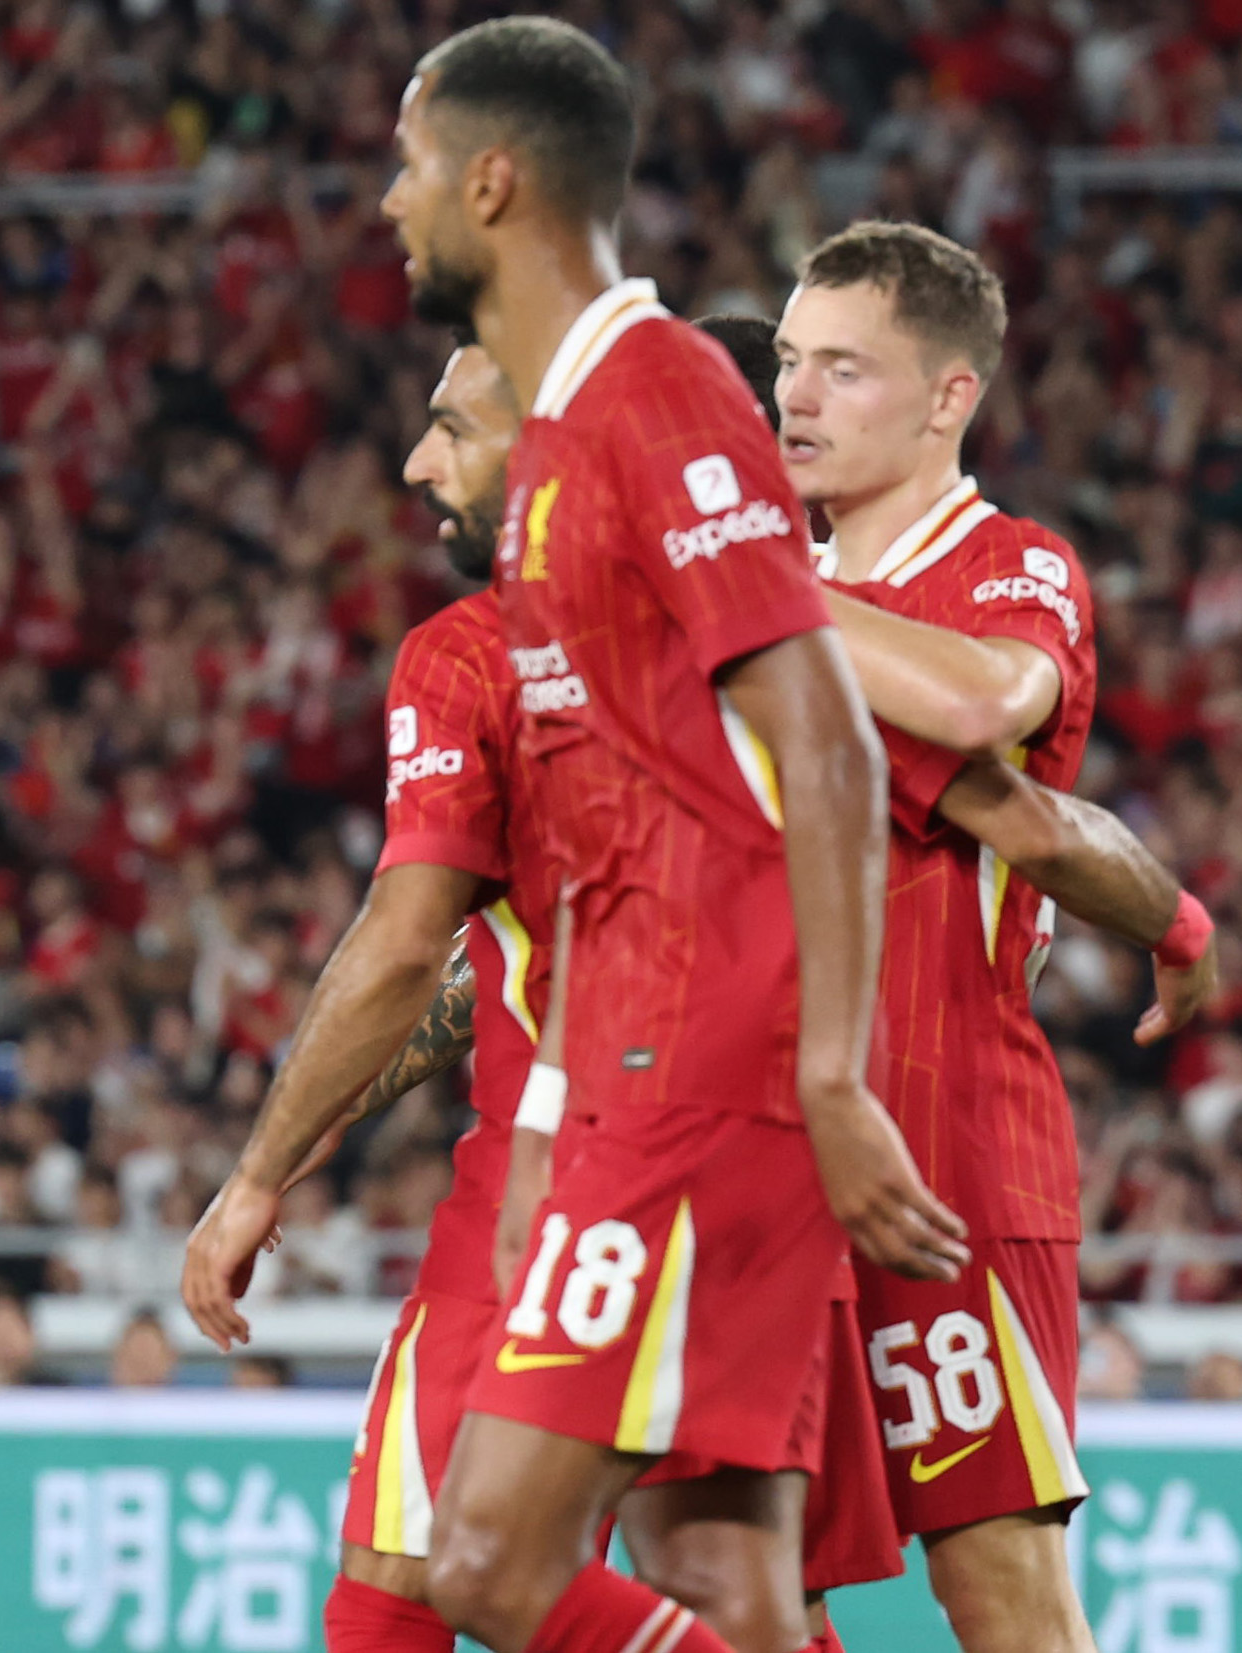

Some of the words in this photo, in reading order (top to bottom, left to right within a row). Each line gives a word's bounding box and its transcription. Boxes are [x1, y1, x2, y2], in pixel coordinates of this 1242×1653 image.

[505, 1212, 649, 1349] 18
[867, 1309, 1006, 1450] 58
[32, 1466, 346, 1652] 明治
[1066, 1477, 1242, 1653] 治
